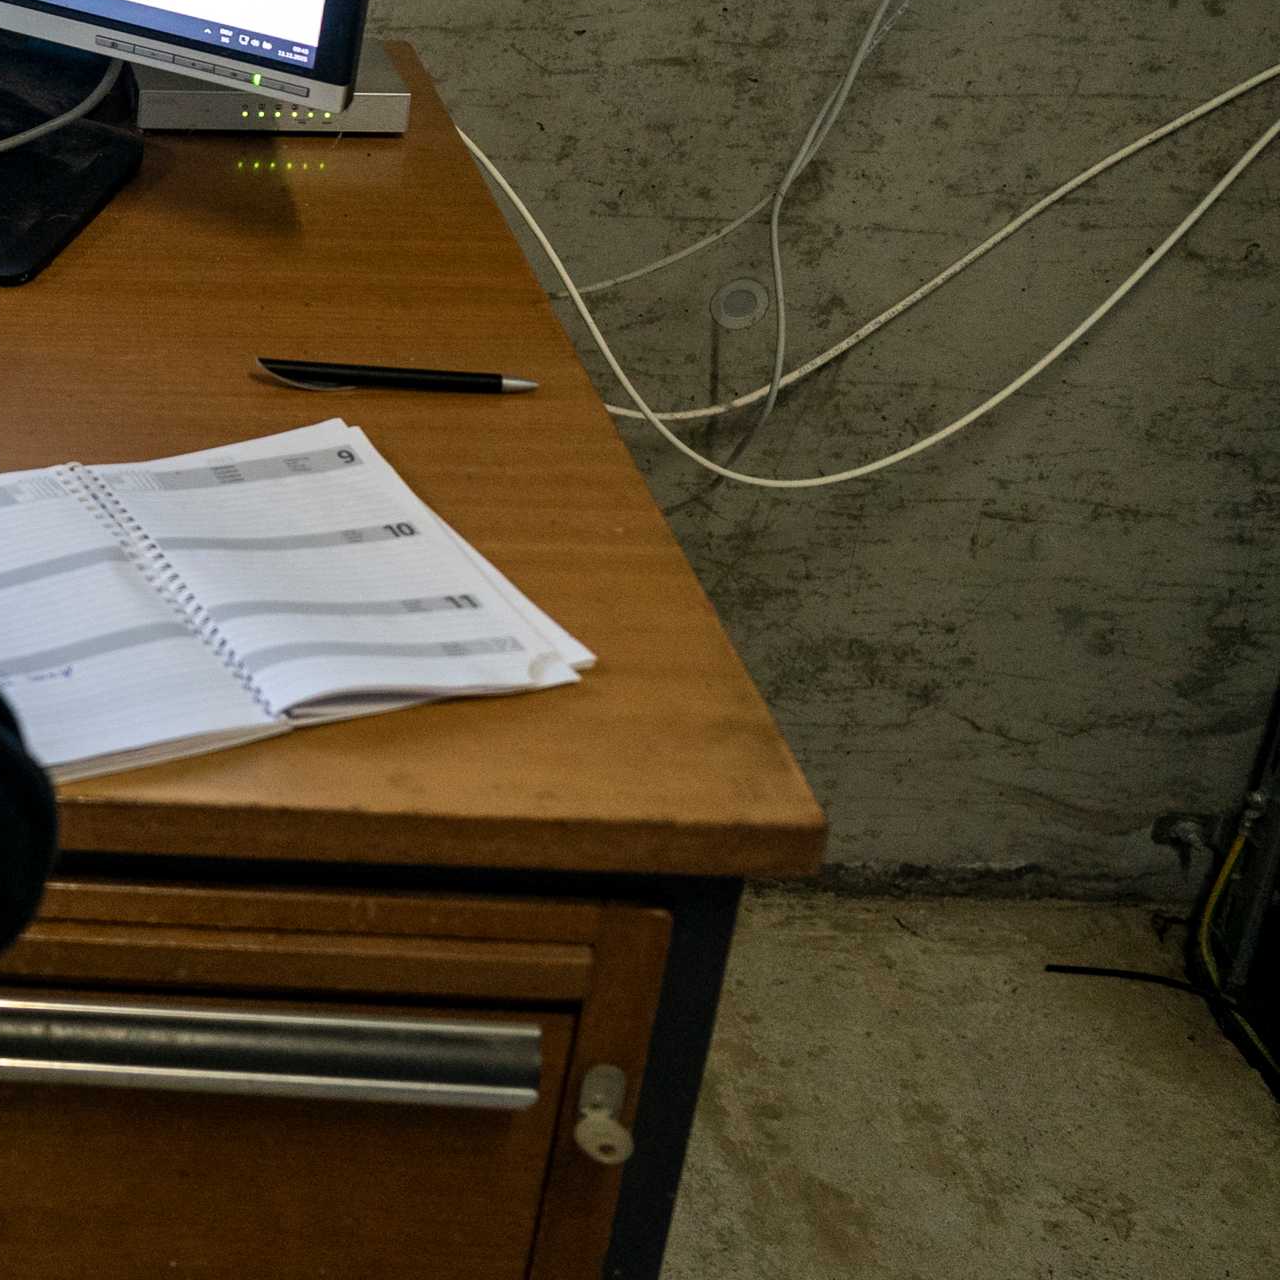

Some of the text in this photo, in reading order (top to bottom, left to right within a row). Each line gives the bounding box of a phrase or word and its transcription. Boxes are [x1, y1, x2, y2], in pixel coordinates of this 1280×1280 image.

[337, 449, 356, 464] 9
[383, 522, 416, 538] 10
[444, 594, 479, 610] 11
